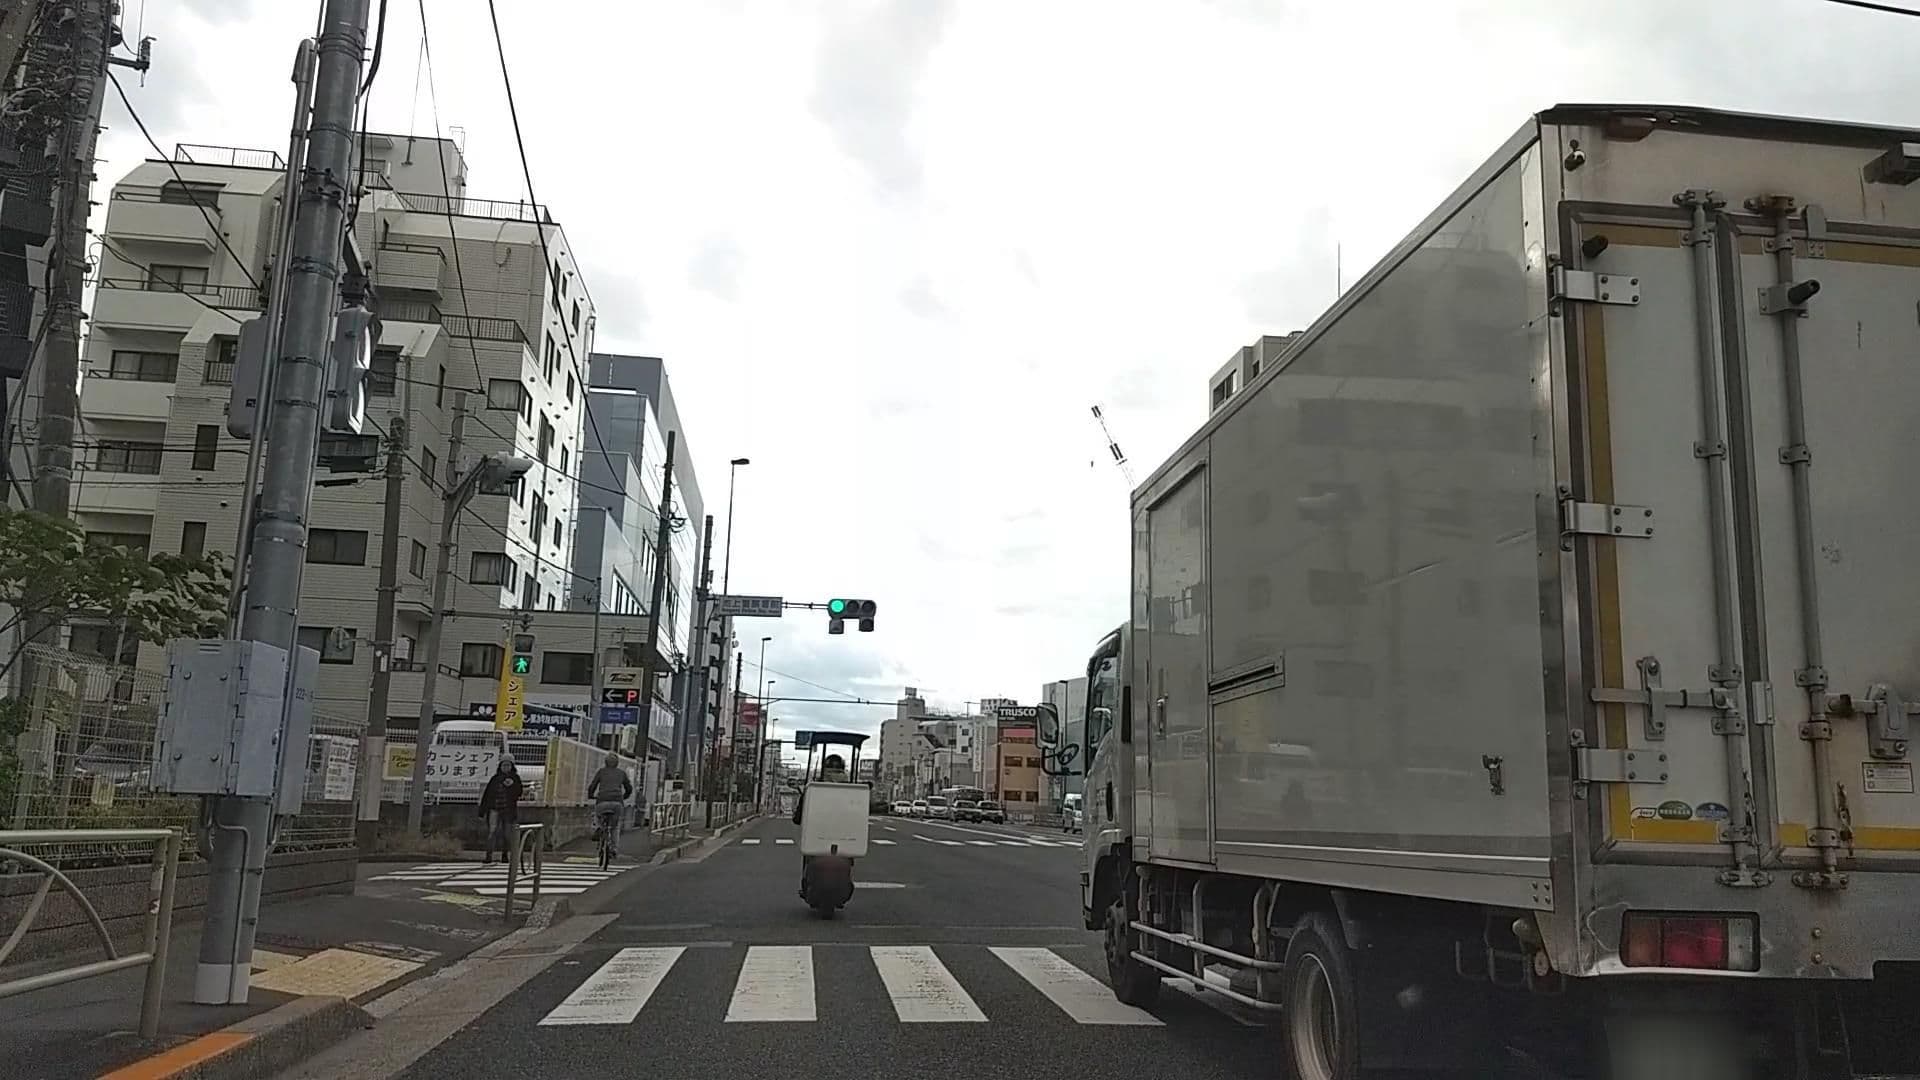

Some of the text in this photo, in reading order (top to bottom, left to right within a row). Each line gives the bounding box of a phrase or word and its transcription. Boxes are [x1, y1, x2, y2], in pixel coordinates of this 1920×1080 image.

[627, 690, 638, 703] P
[999, 708, 1036, 717] TRUSCO
[427, 752, 494, 763] カーシェア
